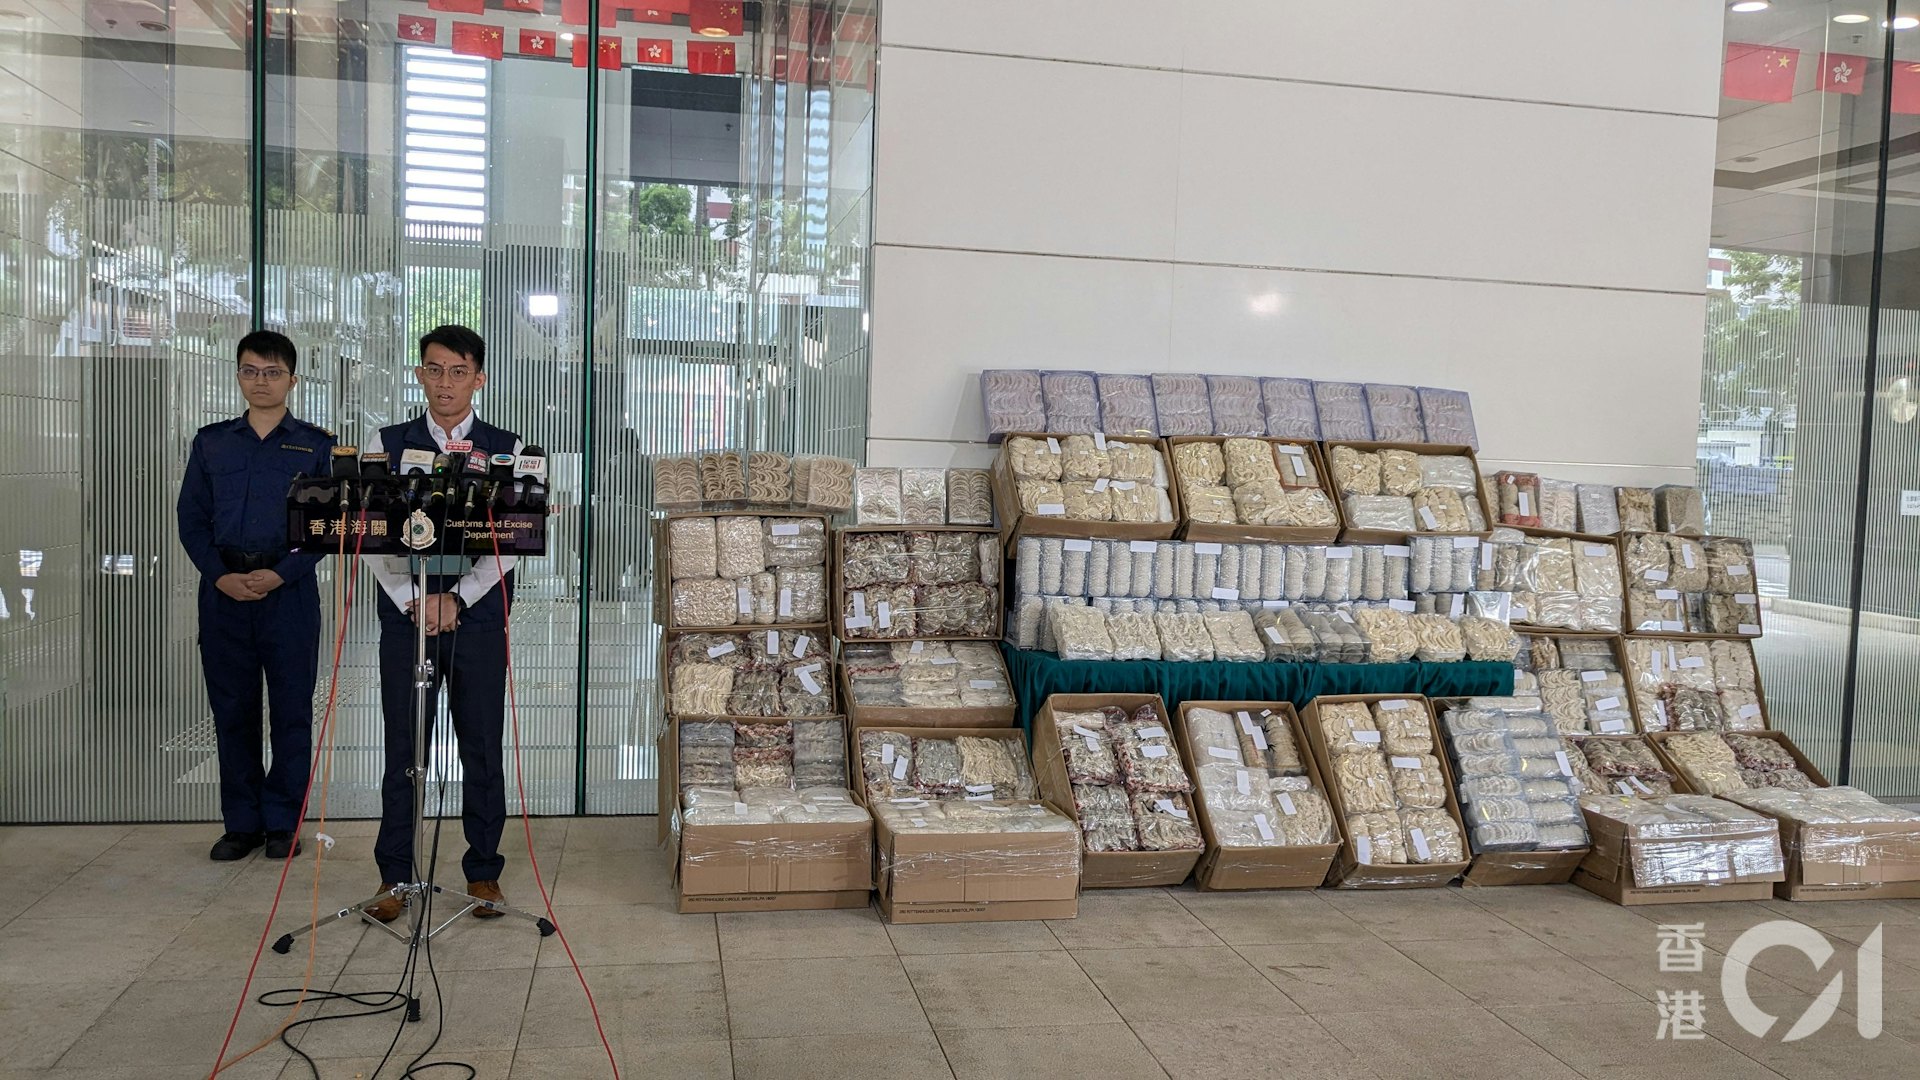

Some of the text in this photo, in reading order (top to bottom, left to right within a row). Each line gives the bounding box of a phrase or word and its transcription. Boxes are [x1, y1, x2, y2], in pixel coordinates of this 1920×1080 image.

[309, 518, 387, 536] 香港海關
[445, 519, 533, 528] Customs and Excise
[464, 530, 514, 541] Department
